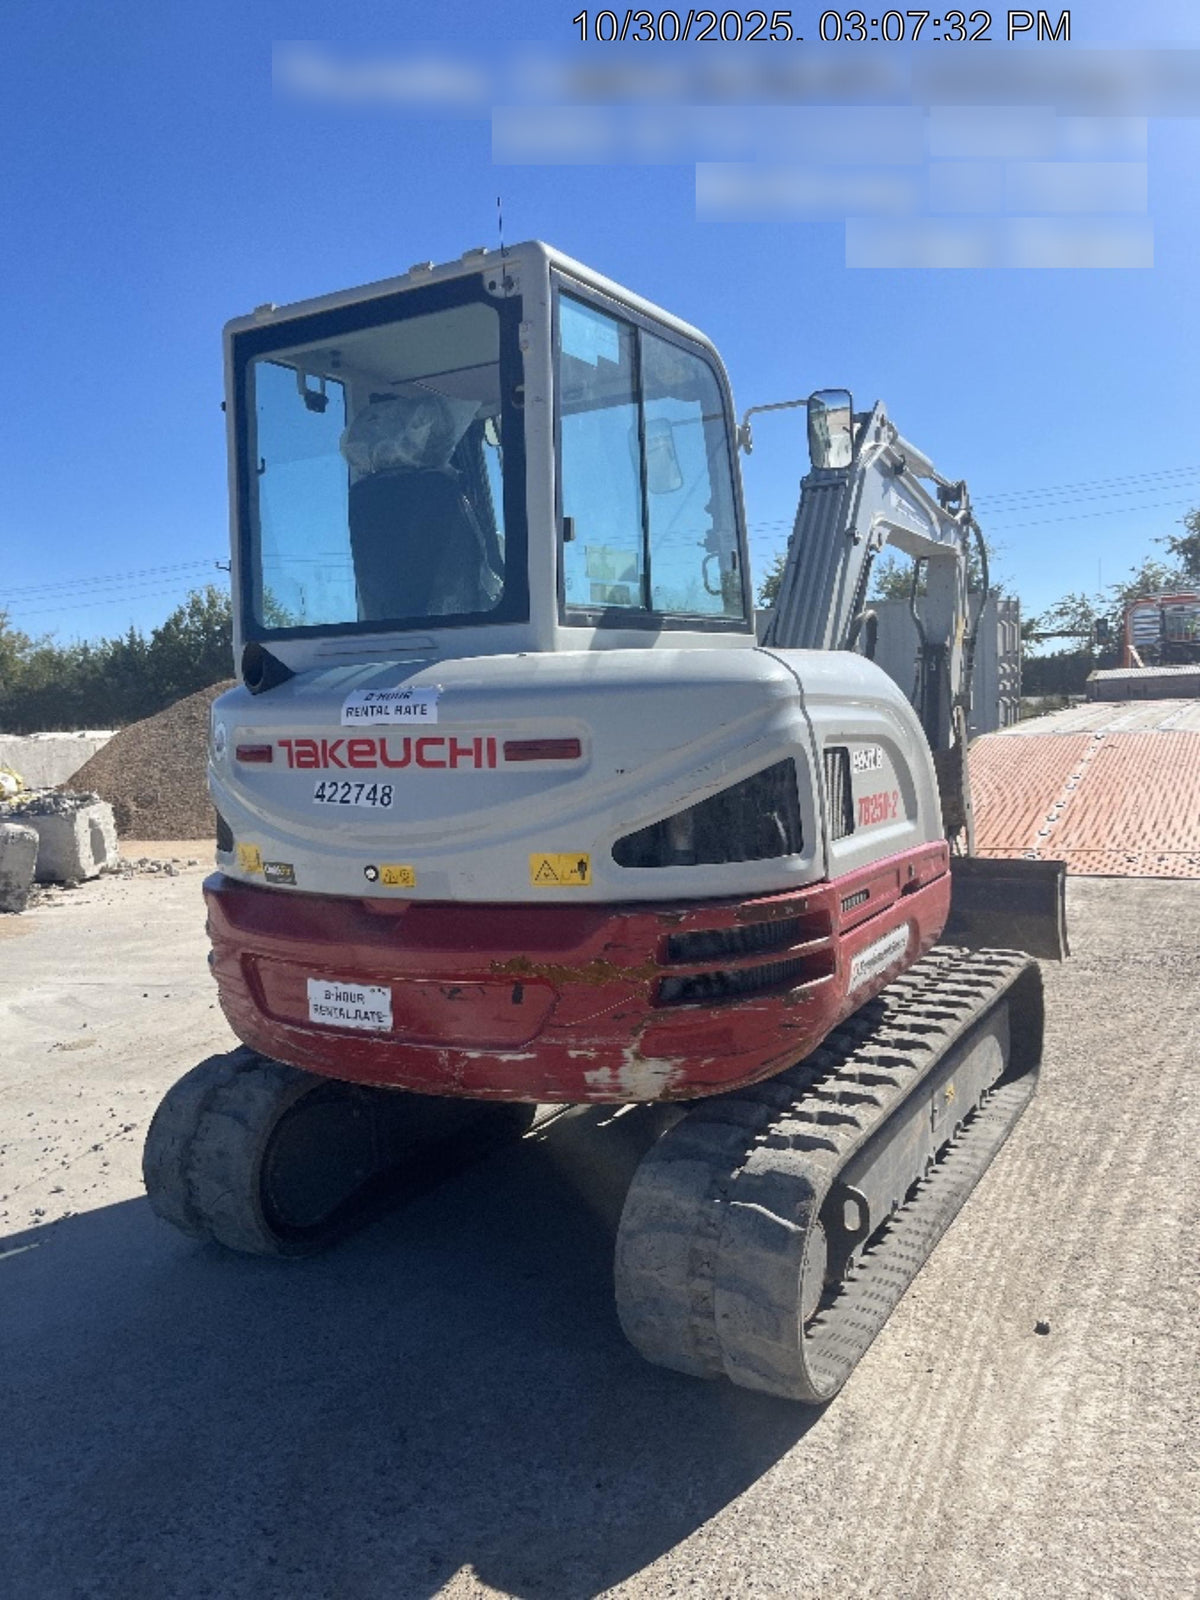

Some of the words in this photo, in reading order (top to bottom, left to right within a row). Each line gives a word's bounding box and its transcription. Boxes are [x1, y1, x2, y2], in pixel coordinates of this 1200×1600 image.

[345, 704, 391, 718] RENTAL
[314, 781, 393, 807] 422748
[313, 1003, 352, 1020] RENTAL
